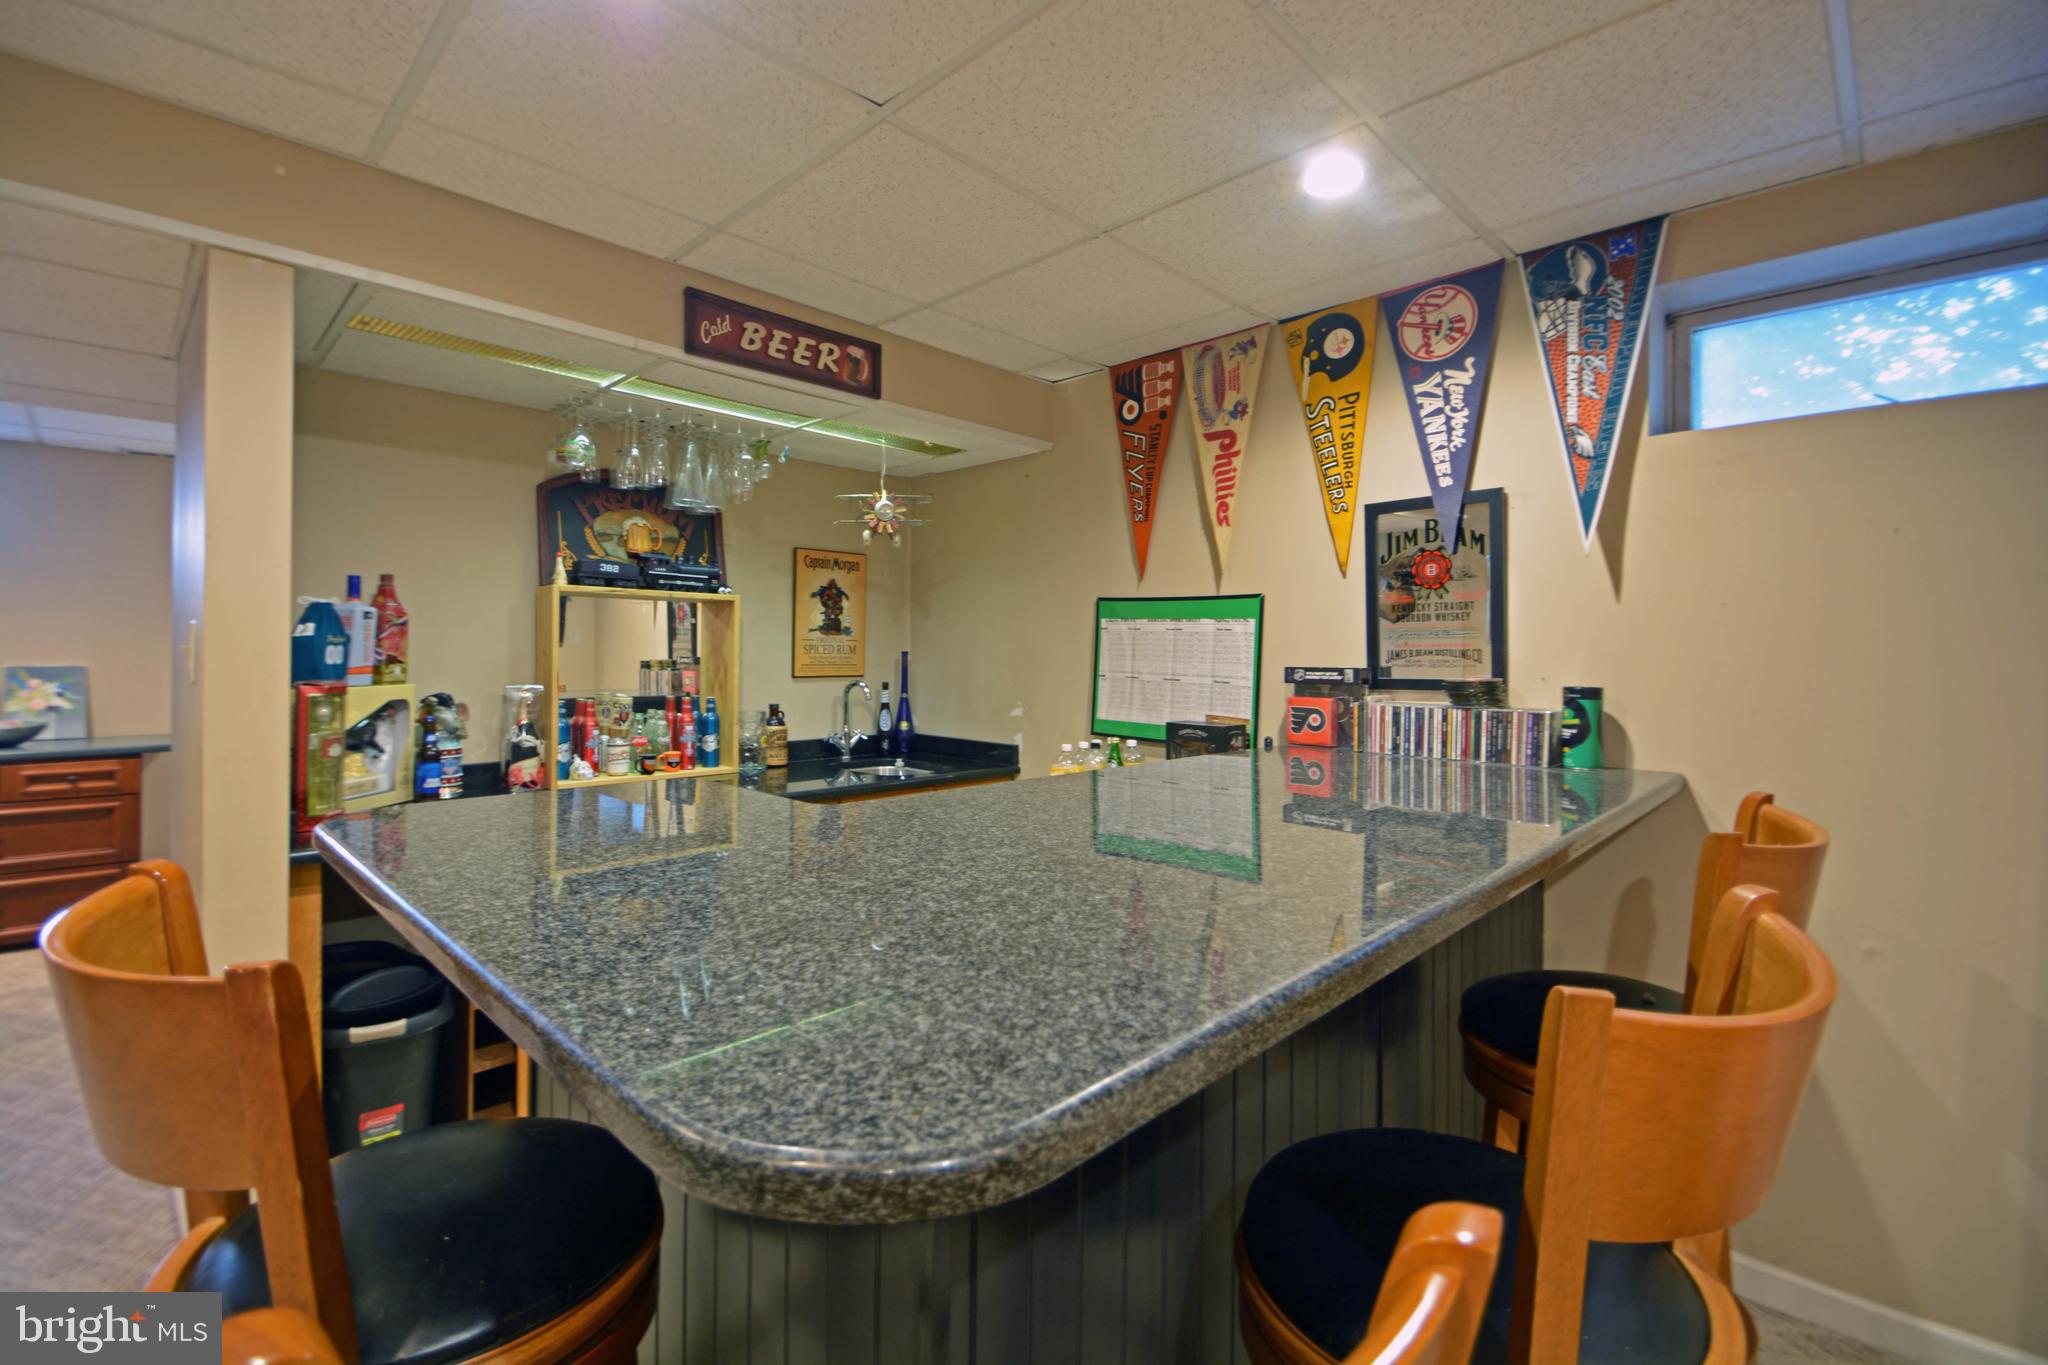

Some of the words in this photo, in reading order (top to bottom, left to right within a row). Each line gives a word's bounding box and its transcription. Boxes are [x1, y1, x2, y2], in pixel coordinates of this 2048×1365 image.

[700, 314, 732, 344] Cold
[740, 321, 841, 374] BEER
[1580, 296, 1609, 352] NFC
[1443, 356, 1476, 409] New
[1566, 354, 1580, 423] CHAMPIONS
[1581, 354, 1608, 401] East
[1147, 423, 1163, 464] STANLEY
[1338, 391, 1361, 489] PITTSBURGH
[1412, 371, 1454, 488] YANKEES
[1444, 404, 1470, 453] York
[1123, 430, 1147, 523] FLYERS
[1202, 428, 1242, 527] Phillies
[1305, 395, 1349, 515] STEELERS
[600, 563, 620, 573] 382
[803, 555, 831, 572] Captain
[831, 558, 860, 574] Morgan
[1380, 528, 1418, 565] JIM
[1434, 600, 1475, 613] STRAIGHT
[1435, 611, 1471, 622] WHISKEY
[803, 644, 835, 656] SPICED
[836, 645, 857, 656] RUM
[1385, 649, 1408, 664] JAMES
[1415, 648, 1433, 657] BEAM
